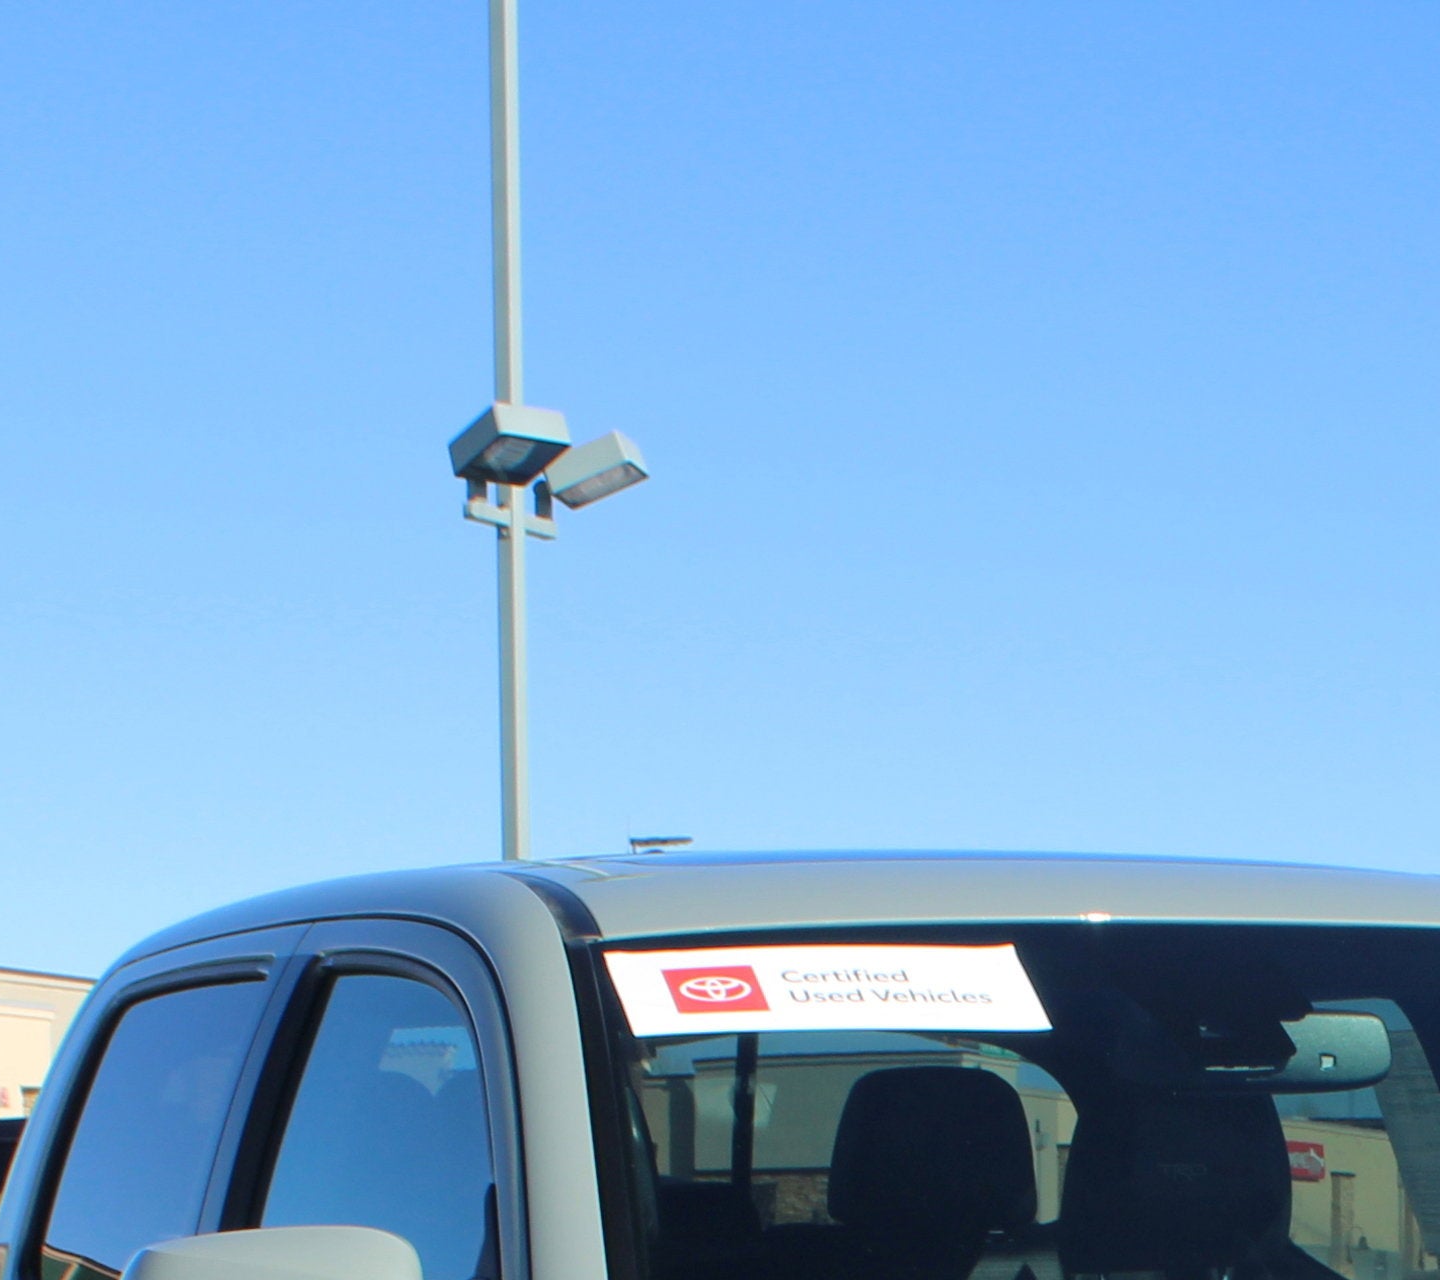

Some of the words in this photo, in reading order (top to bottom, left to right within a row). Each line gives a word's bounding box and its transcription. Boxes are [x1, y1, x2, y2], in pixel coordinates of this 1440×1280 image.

[781, 968, 910, 984] Certified
[788, 988, 865, 1004] Used
[870, 988, 993, 1004] Vehicles
